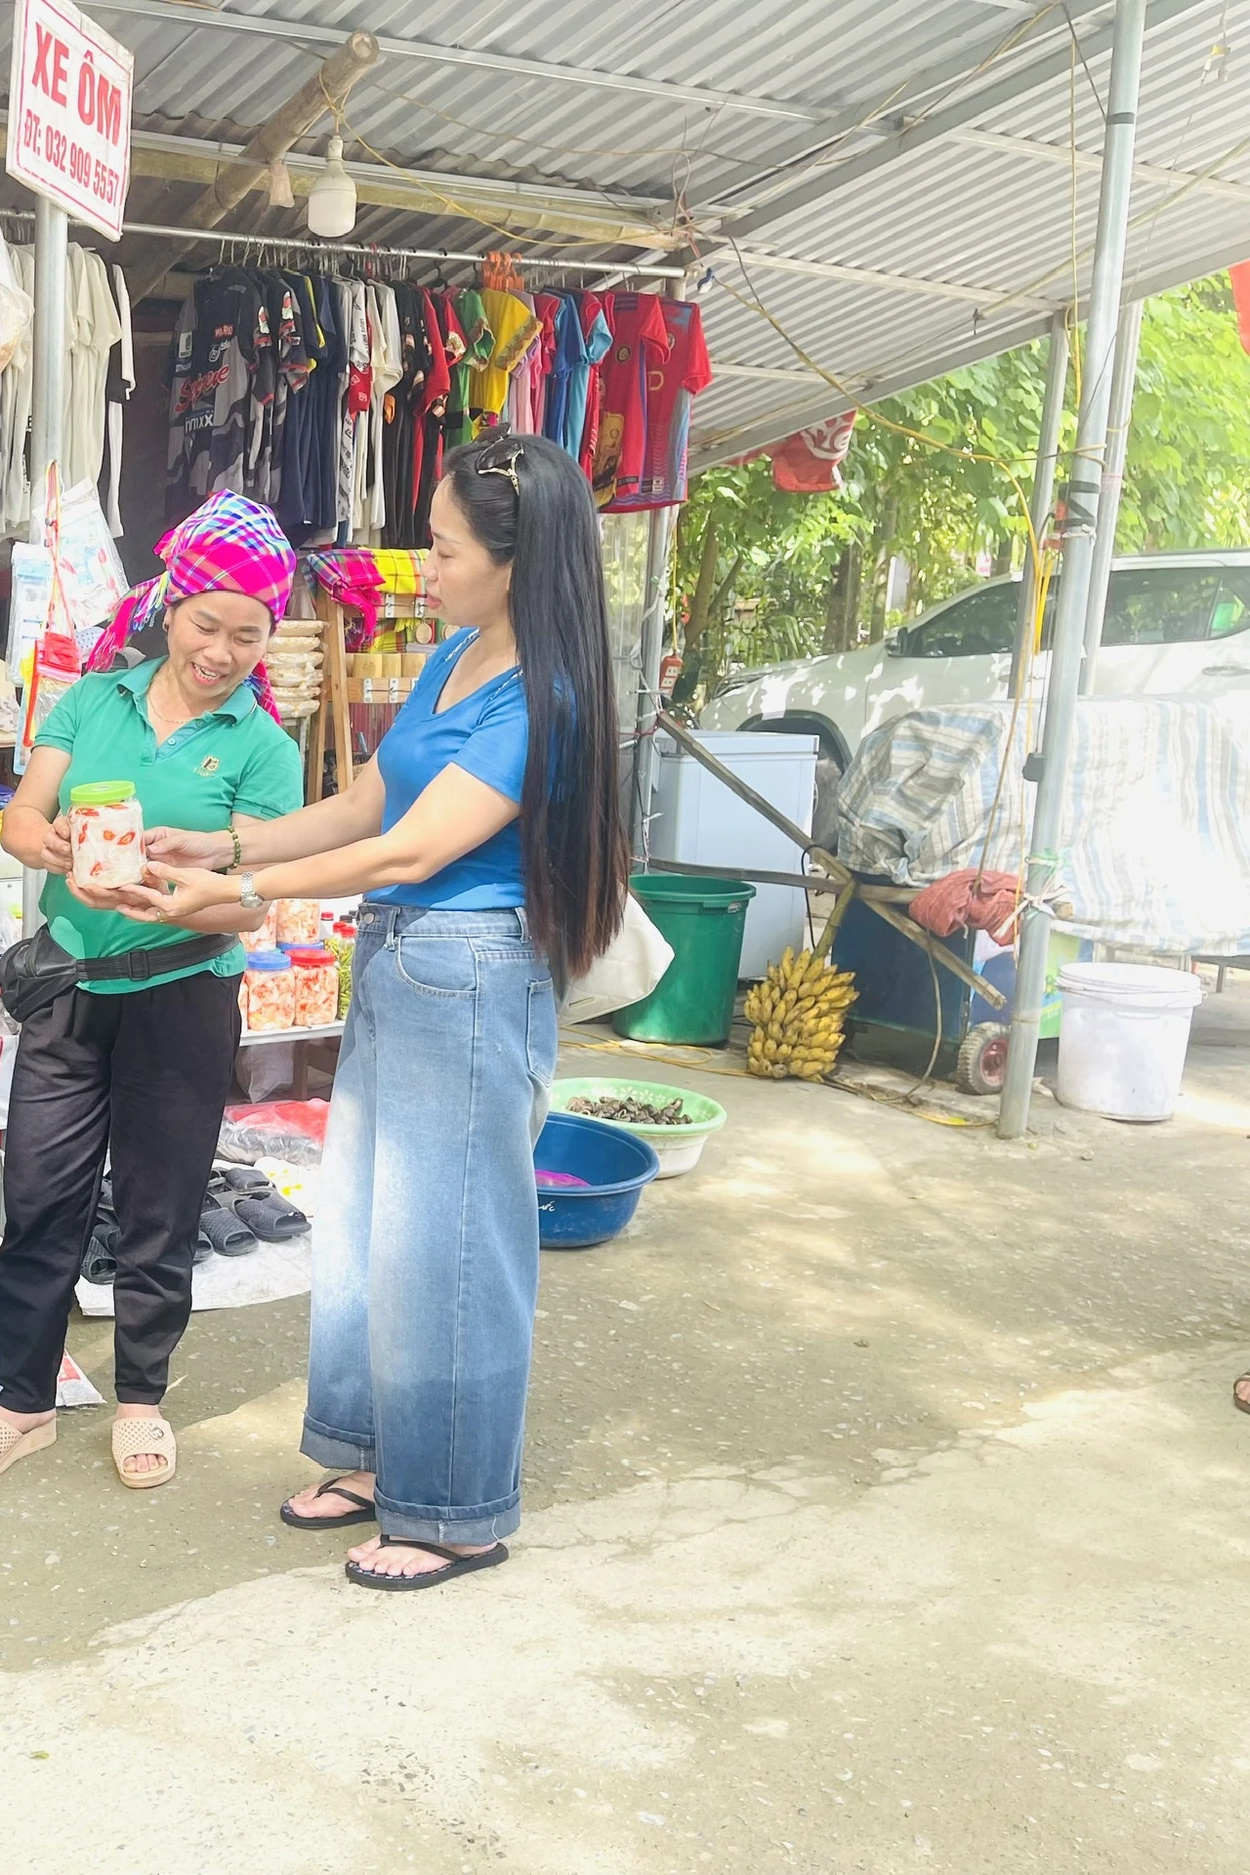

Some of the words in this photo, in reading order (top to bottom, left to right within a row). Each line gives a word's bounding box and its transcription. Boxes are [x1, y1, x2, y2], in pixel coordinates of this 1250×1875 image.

[31, 21, 69, 108] XE
[77, 49, 122, 147] ÔM
[23, 108, 42, 157] ĐT:
[45, 125, 66, 173] 032
[69, 142, 91, 189] 909
[92, 158, 120, 207] 5557
